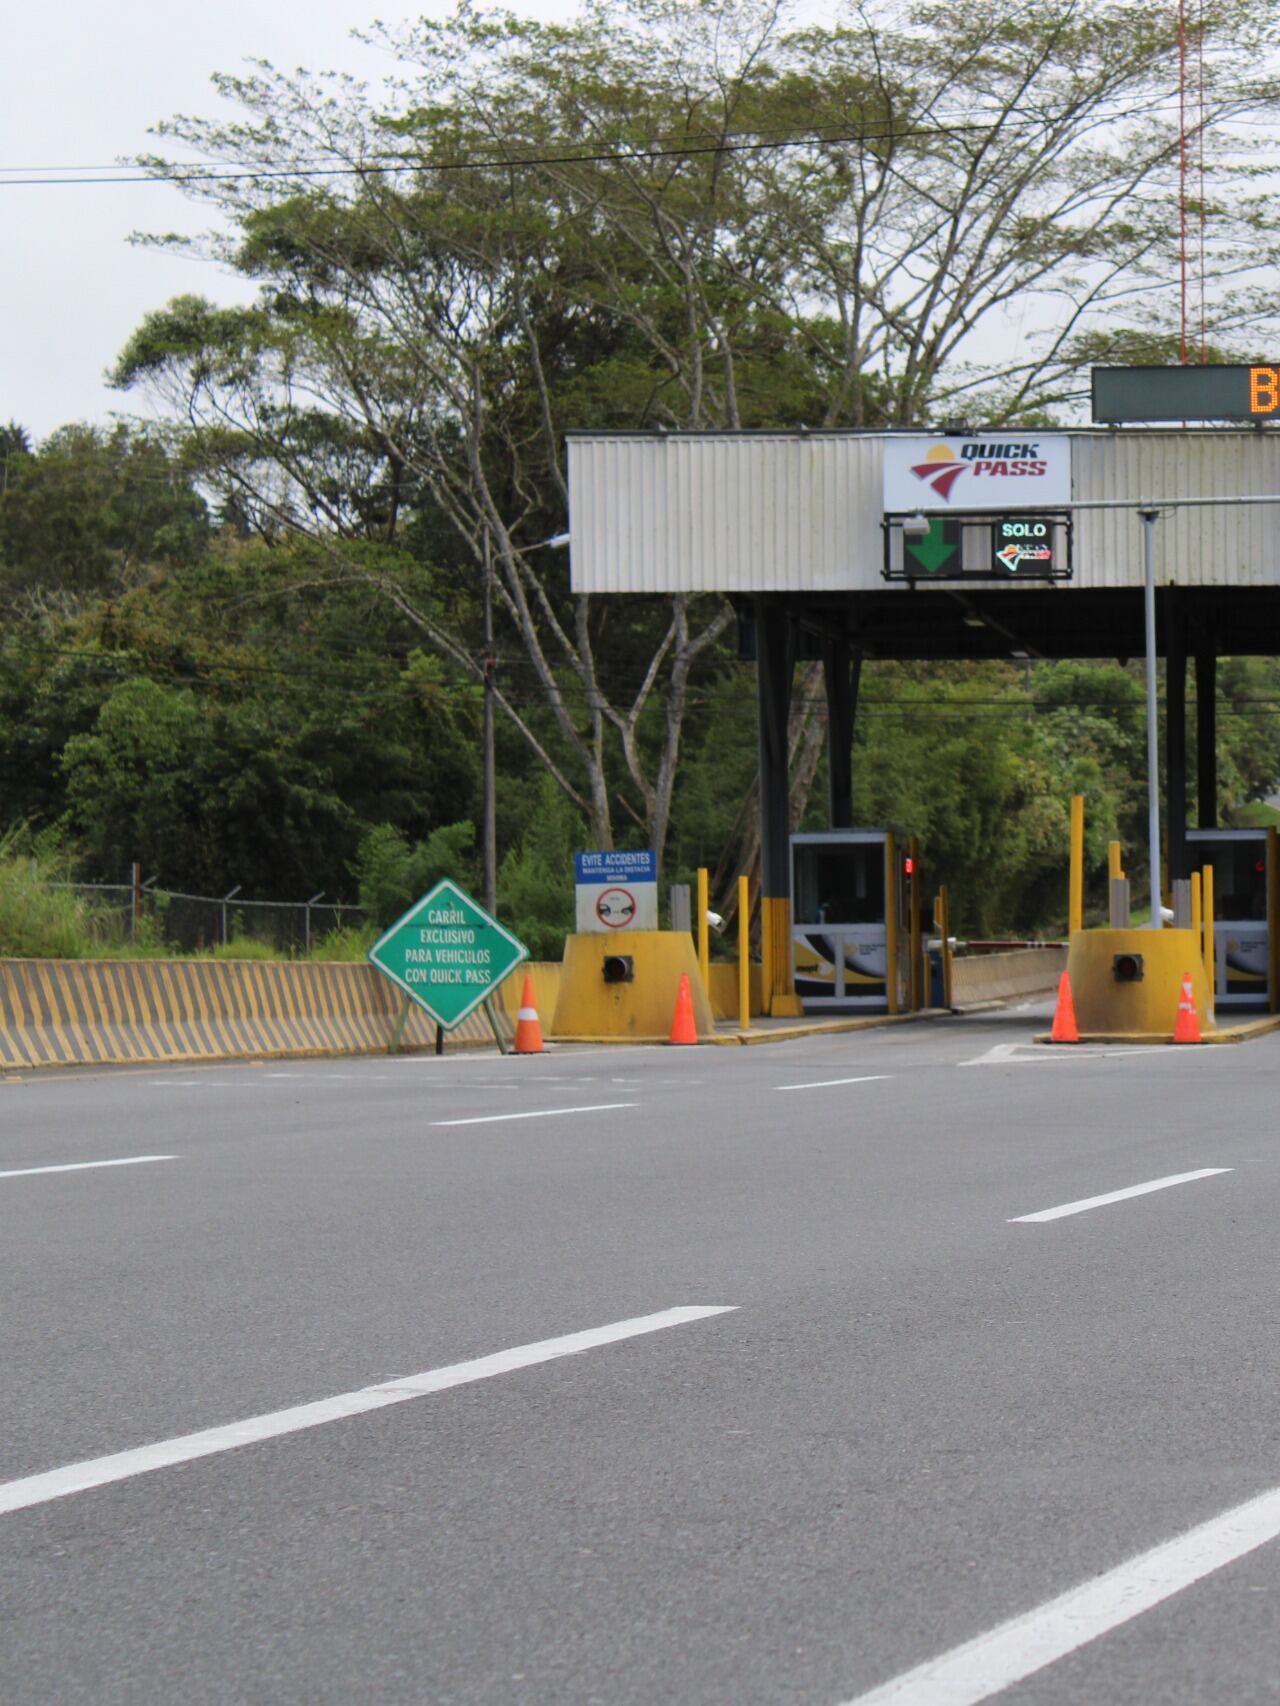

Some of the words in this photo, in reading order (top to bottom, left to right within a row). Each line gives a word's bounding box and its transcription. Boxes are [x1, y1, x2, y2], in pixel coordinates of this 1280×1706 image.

[961, 443, 1039, 460] QUICK
[973, 461, 1047, 476] PASS
[1002, 523, 1047, 537] SOLO
[581, 854, 602, 866] EVITE
[605, 852, 650, 866] ACCIDENTES
[428, 910, 466, 924] CARRIL
[420, 929, 475, 944] EXCLUSIVO
[405, 949, 432, 963] PARA
[435, 949, 491, 964] VEHICULOS
[405, 968, 427, 982] CON
[430, 968, 462, 984] QUICK
[465, 969, 492, 984] PASS
